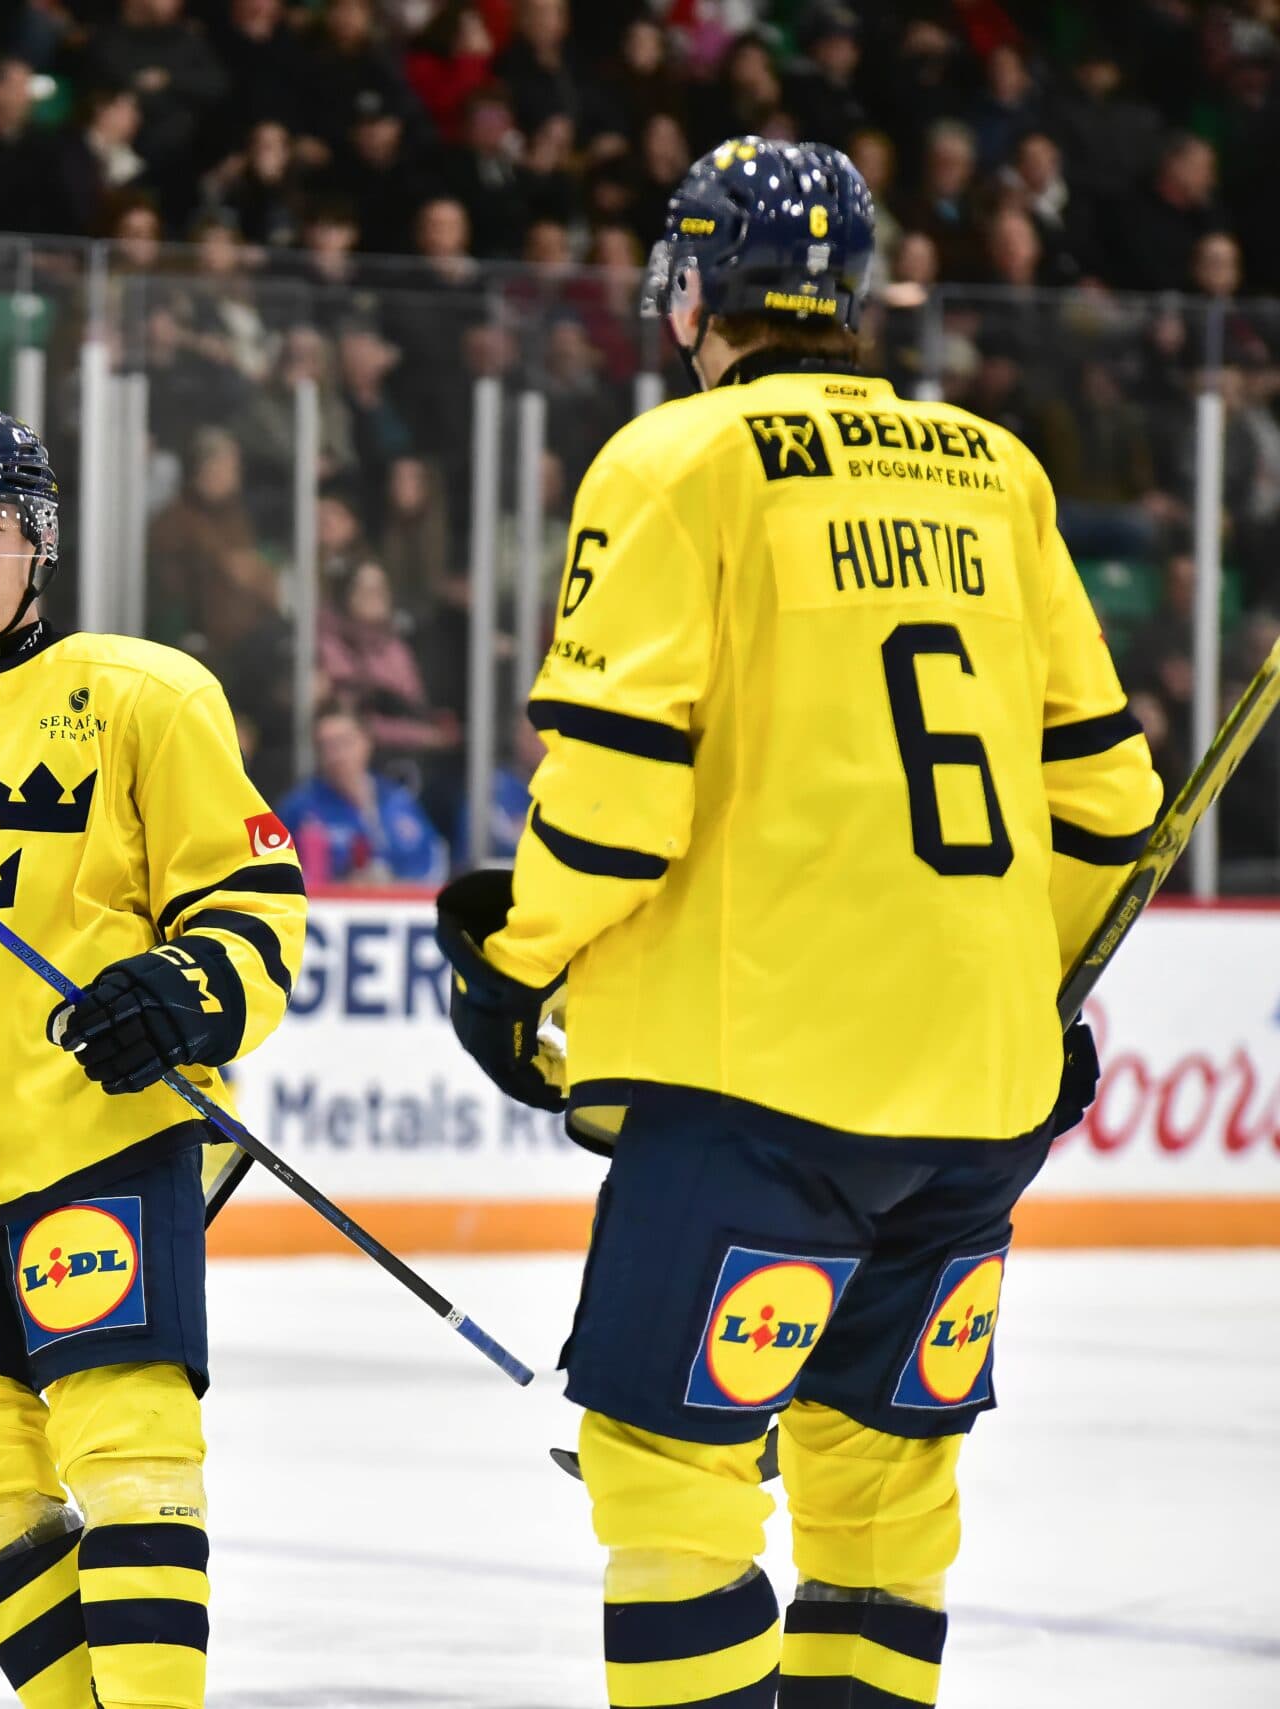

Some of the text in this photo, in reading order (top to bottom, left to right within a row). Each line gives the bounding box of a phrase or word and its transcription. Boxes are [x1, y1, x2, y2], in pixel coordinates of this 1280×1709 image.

[809, 205, 829, 238] 6
[829, 409, 997, 462] BEIJER
[847, 459, 1006, 493] BYGGMATERIAL
[562, 528, 608, 618] 6
[828, 517, 986, 597] HURTIG
[880, 621, 1015, 878] 6
[270, 1074, 484, 1150] Metals
[158, 1505, 201, 1518] CCM
